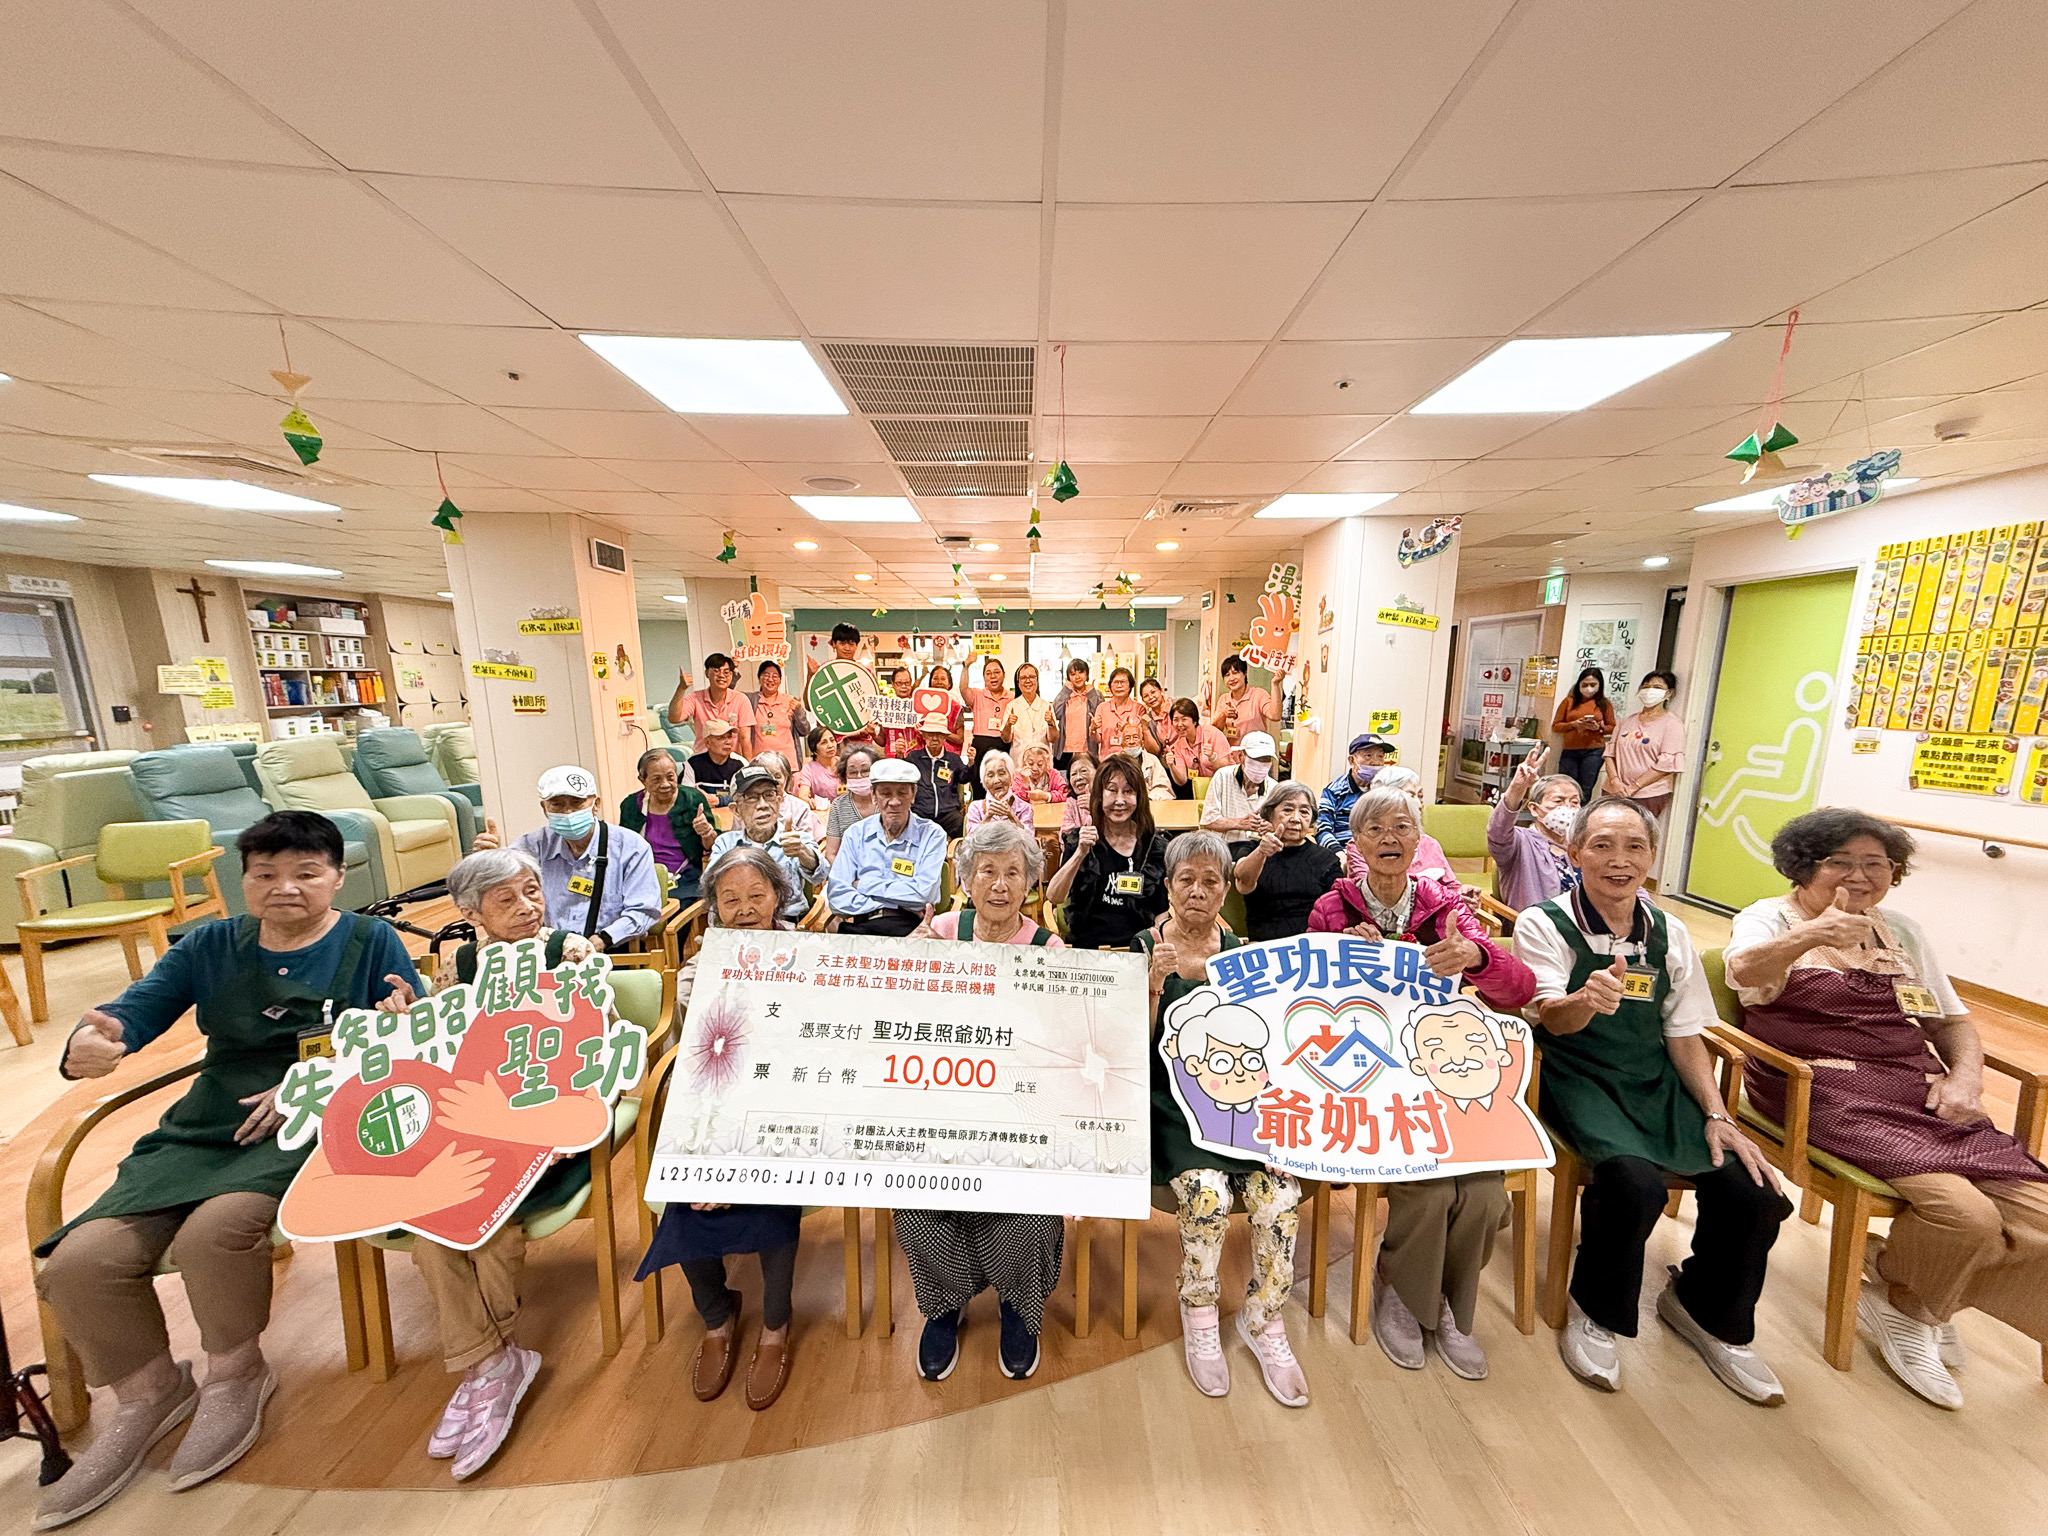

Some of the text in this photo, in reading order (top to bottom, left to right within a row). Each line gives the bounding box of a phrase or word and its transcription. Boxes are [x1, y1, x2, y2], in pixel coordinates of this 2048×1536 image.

[723, 602, 751, 623] 準備
[733, 643, 789, 660] 好的環境
[1242, 647, 1296, 671] 心陪伴
[523, 695, 546, 707] 廁所
[867, 696, 913, 712] 蒙特梭利
[872, 711, 918, 725] 失智照顧
[1372, 712, 1398, 721] 衛生紙
[1930, 737, 2000, 749] 您願意一起來
[816, 954, 997, 977] 天主教聖功醫療財團法人附設
[1014, 968, 1045, 979] 支票號碼
[1210, 938, 1453, 1005] 聖功長照
[721, 968, 807, 983] 聖功失智日照中心
[813, 973, 996, 996] 高雄市私立聖功社區長照機構
[1013, 982, 1044, 992] 中華民國
[799, 1020, 1013, 1047] 憑票支付 聖功長照爺奶村
[792, 1066, 857, 1085] 新台幣
[883, 1054, 1037, 1093] 10,000 此至
[401, 1103, 420, 1135] 聖功
[1257, 1088, 1450, 1156] 爺奶村
[854, 1125, 1049, 1145] 財團法人天主教聖母無原罪方濟傳教修女會
[853, 1138, 926, 1153] 聖功長照爺奶村
[515, 1152, 547, 1191] HOSPITAL
[1267, 1153, 1439, 1177] St. Joseph Long-term Care Center
[884, 1174, 982, 1192] 000000000
